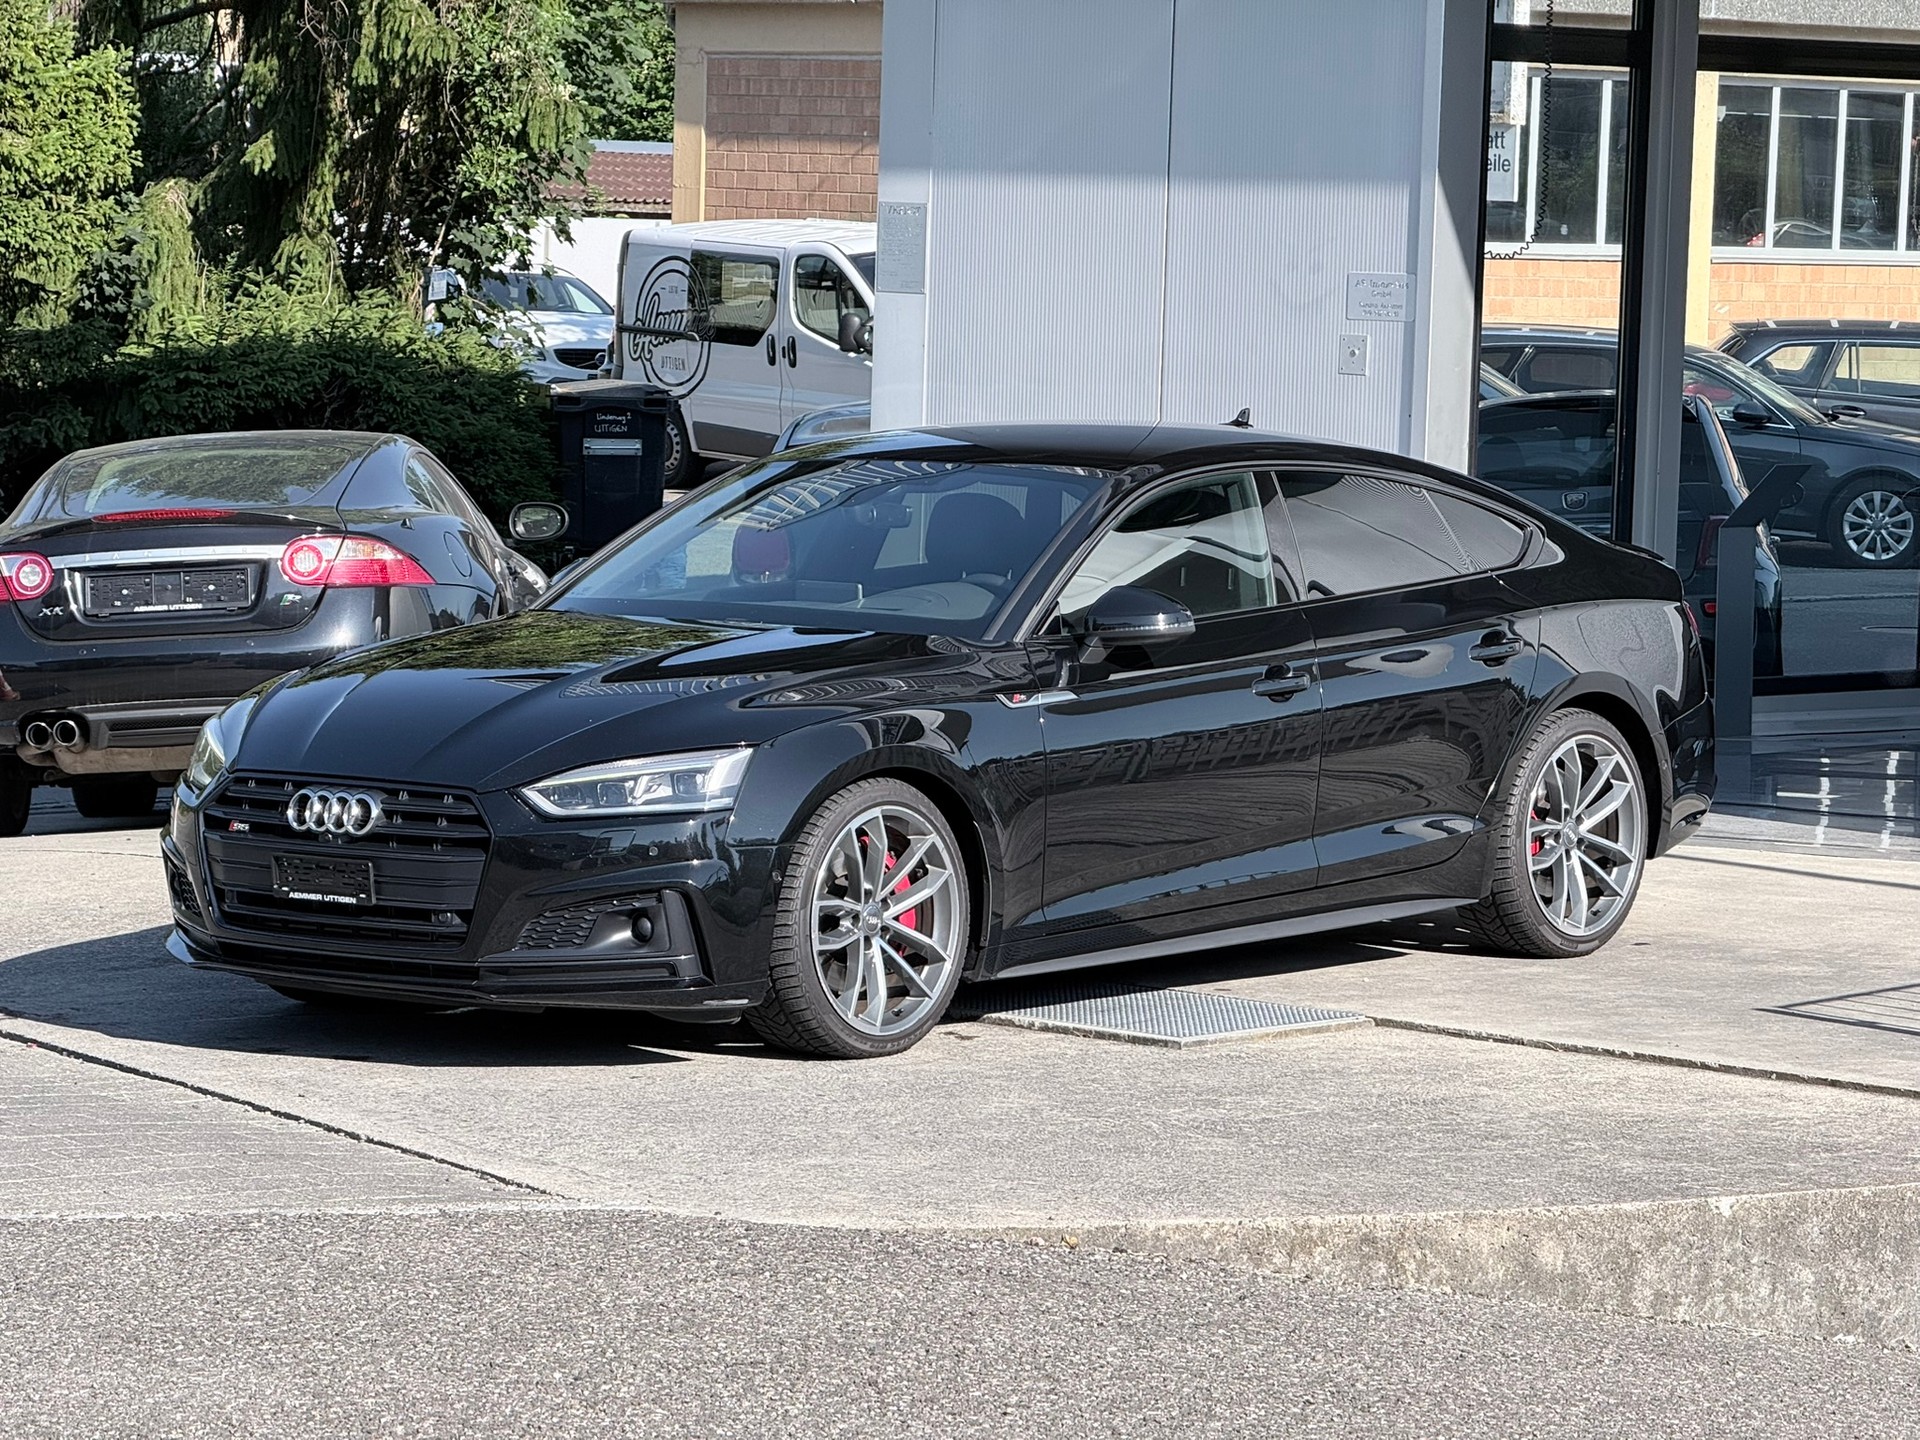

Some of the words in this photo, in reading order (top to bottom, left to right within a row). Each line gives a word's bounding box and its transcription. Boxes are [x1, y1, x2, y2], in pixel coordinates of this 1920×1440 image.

[661, 356, 686, 371] UTTIGEN
[627, 411, 632, 419] 2
[39, 606, 64, 617] XK
[288, 891, 322, 901] AEMMER
[323, 894, 357, 904] UTTIGEN
